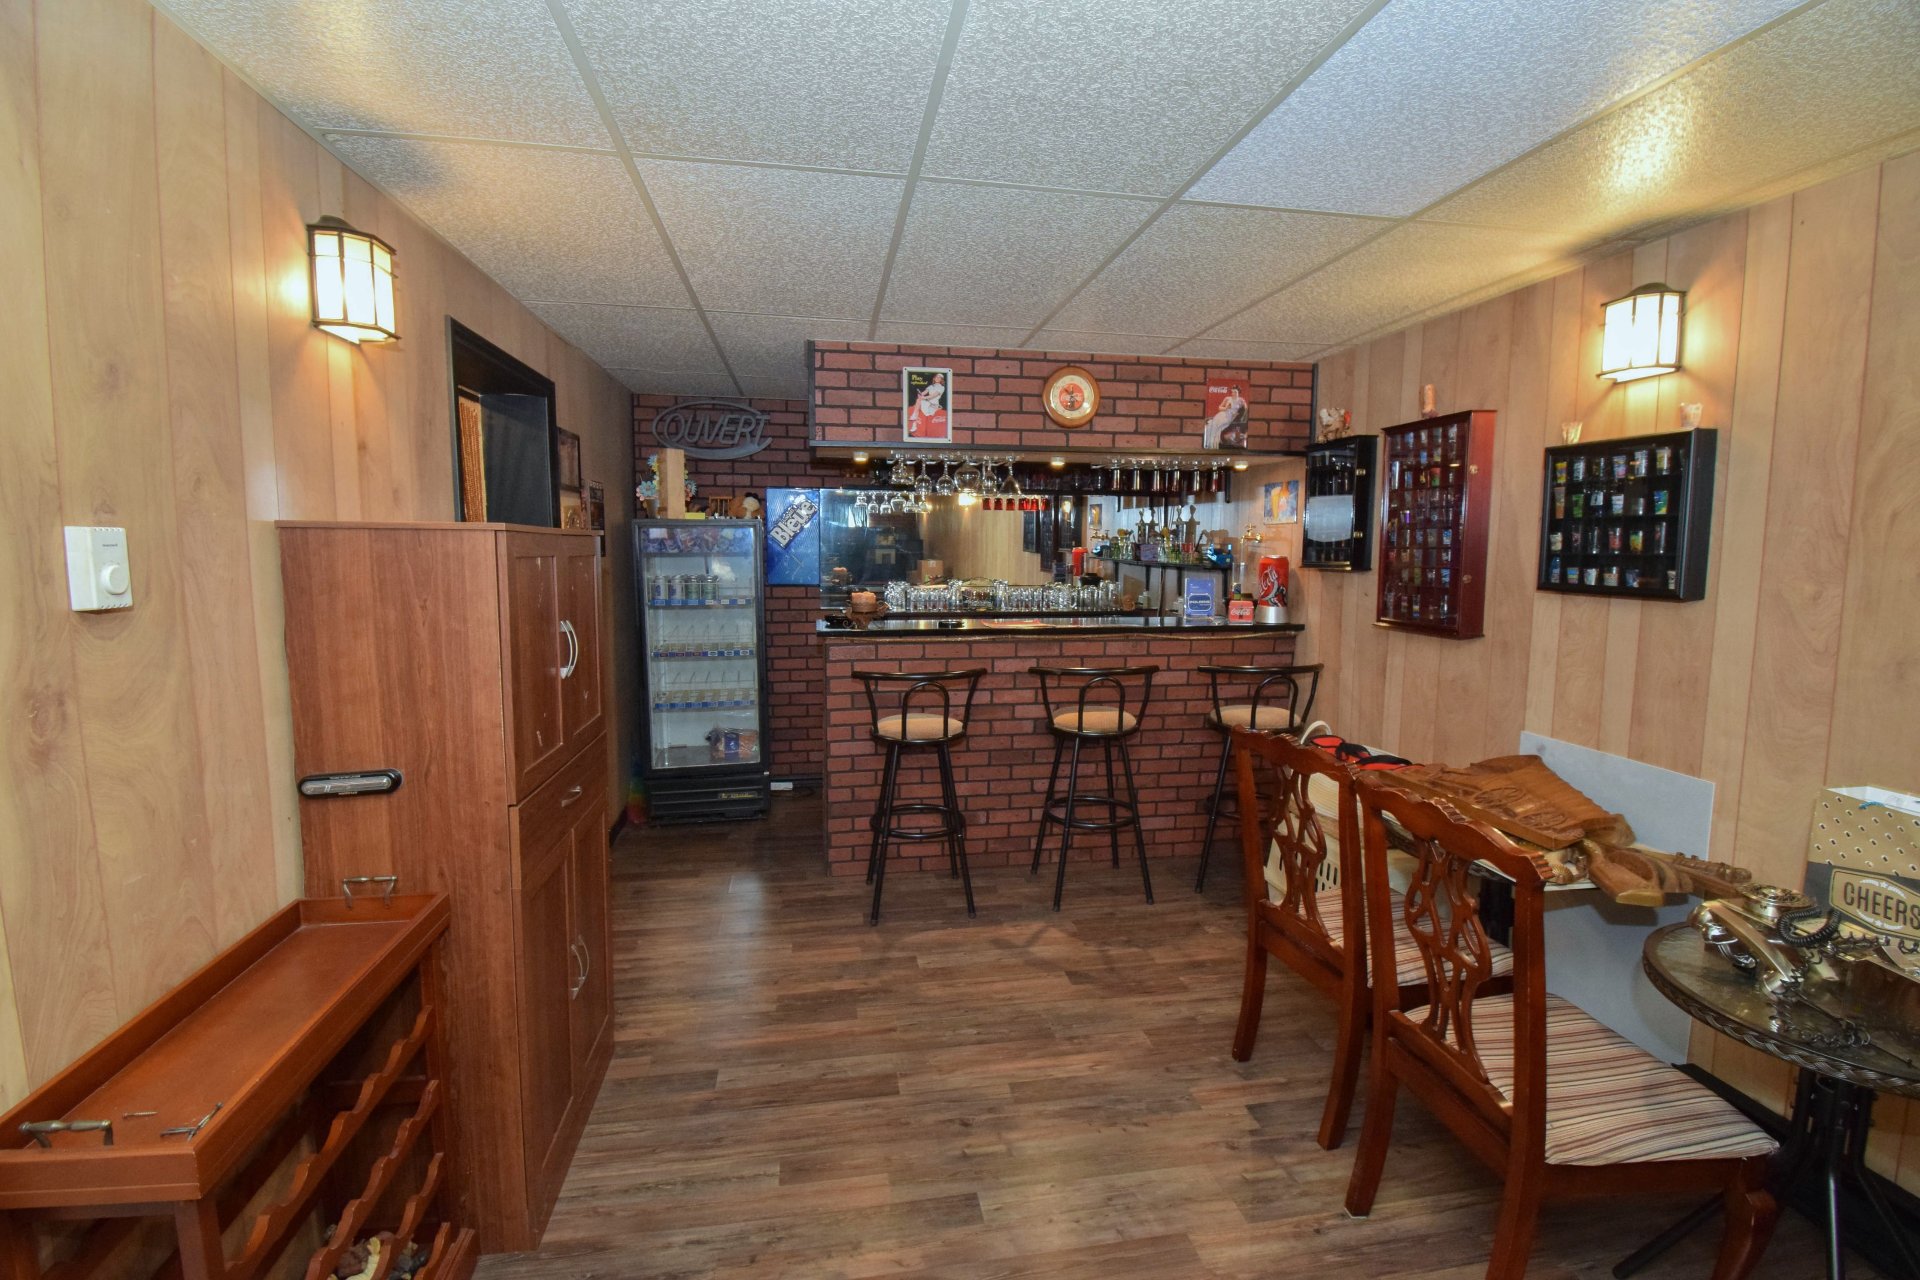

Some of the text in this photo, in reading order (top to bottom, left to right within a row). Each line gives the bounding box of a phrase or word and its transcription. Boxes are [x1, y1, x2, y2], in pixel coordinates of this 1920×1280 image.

[664, 412, 770, 449] OUVERT
[770, 500, 816, 546] Bleue
[1843, 881, 1920, 930] CHEERS
